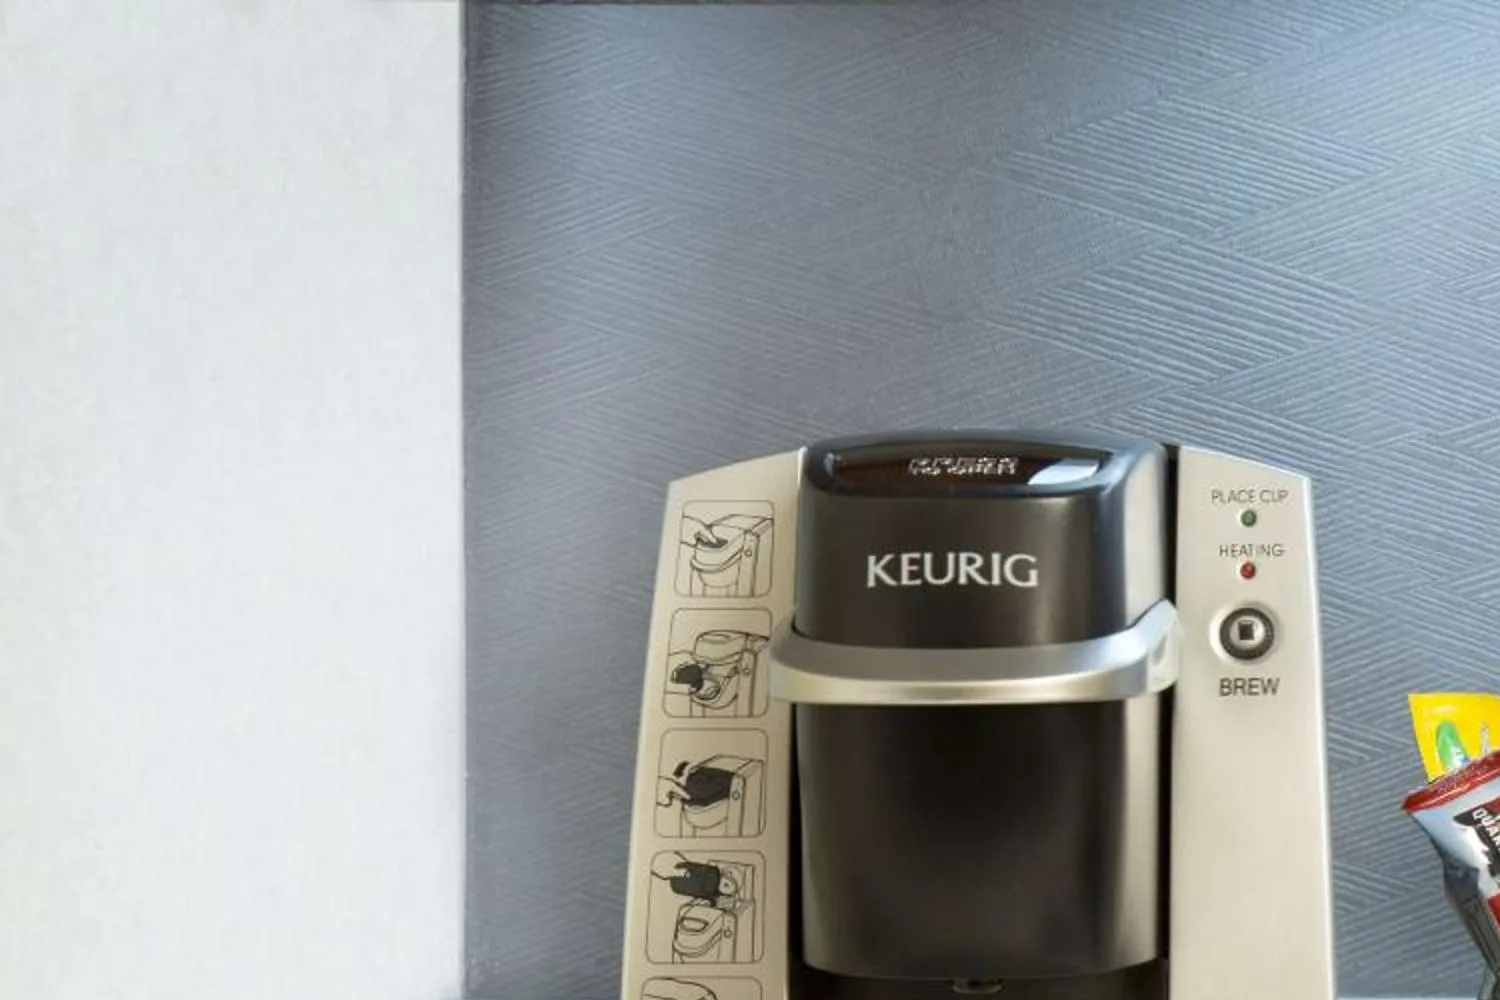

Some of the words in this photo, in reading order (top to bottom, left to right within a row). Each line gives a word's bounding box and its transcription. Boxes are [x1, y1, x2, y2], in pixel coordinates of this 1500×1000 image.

[1211, 489, 1255, 504] PLACE
[1259, 489, 1289, 504] CUP
[1219, 543, 1285, 558] HEATING
[867, 552, 1039, 587] KEURIG
[1219, 677, 1280, 697] BREW
